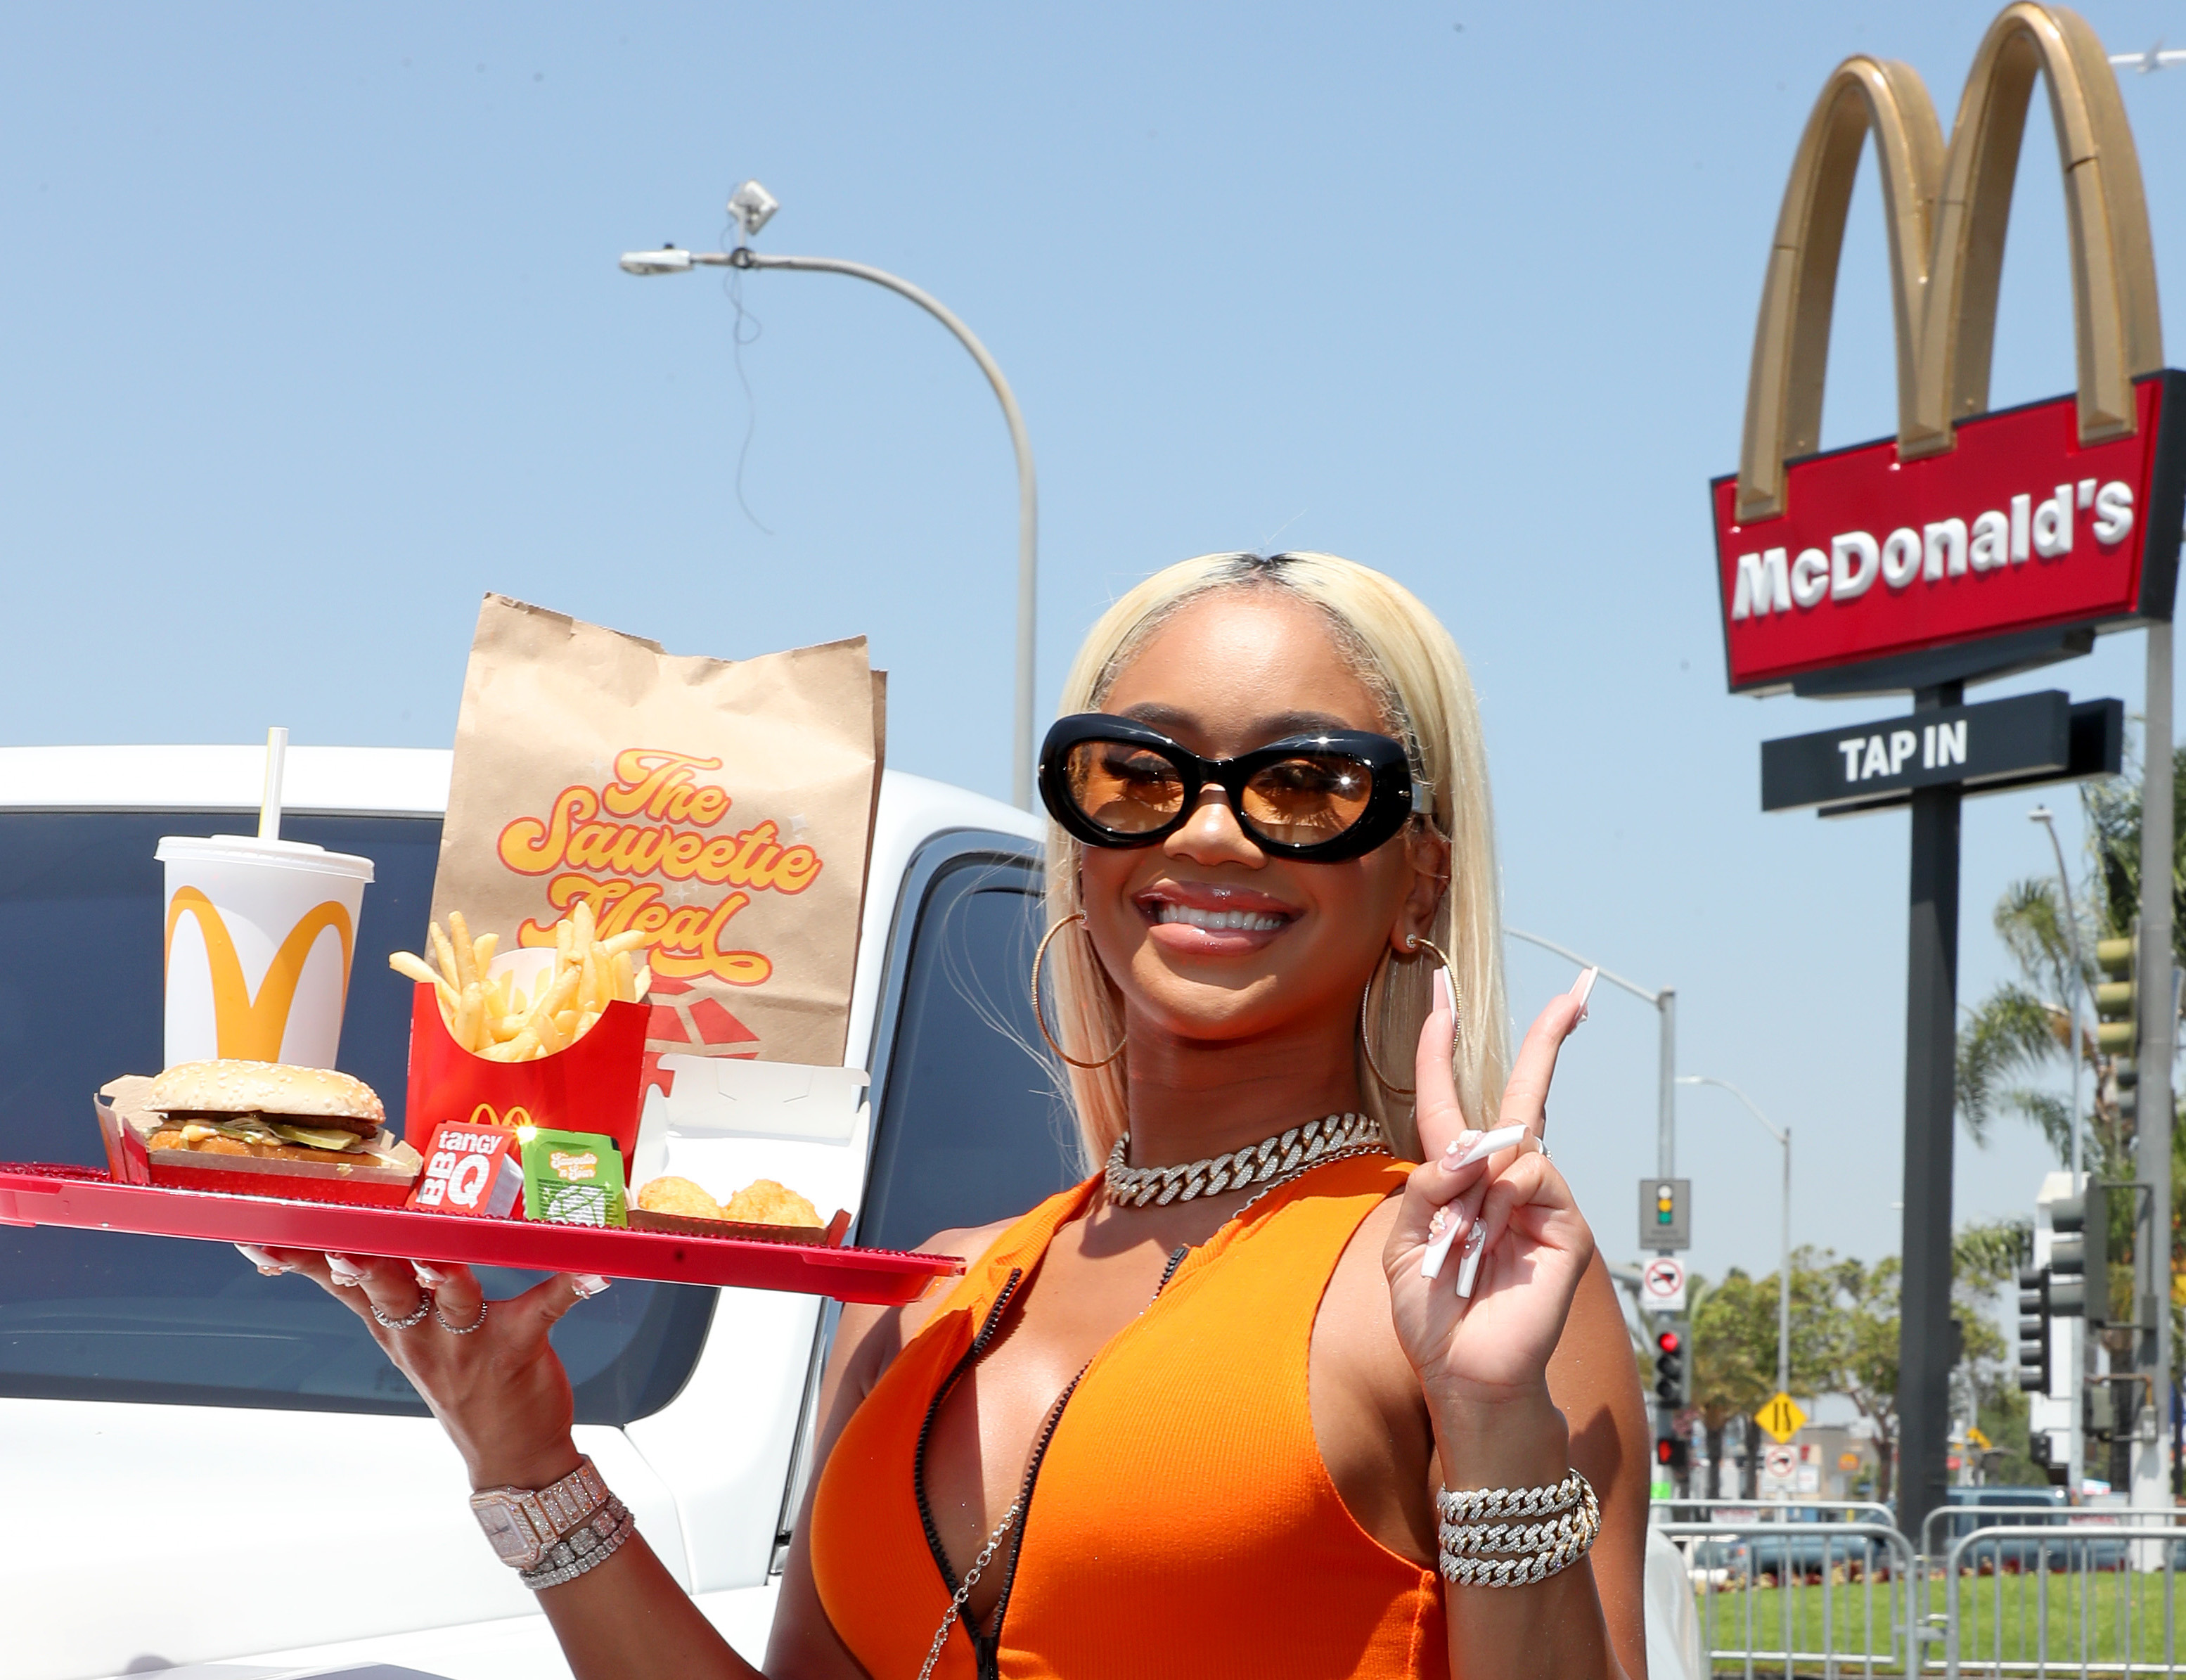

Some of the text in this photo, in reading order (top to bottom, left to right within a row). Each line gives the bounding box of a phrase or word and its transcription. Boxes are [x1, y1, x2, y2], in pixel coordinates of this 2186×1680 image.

[1731, 478, 2134, 621] McDonald's
[602, 748, 732, 828] The
[1838, 719, 1967, 783] TAP IN
[497, 785, 823, 895] Saweetie
[517, 873, 773, 987] Meal
